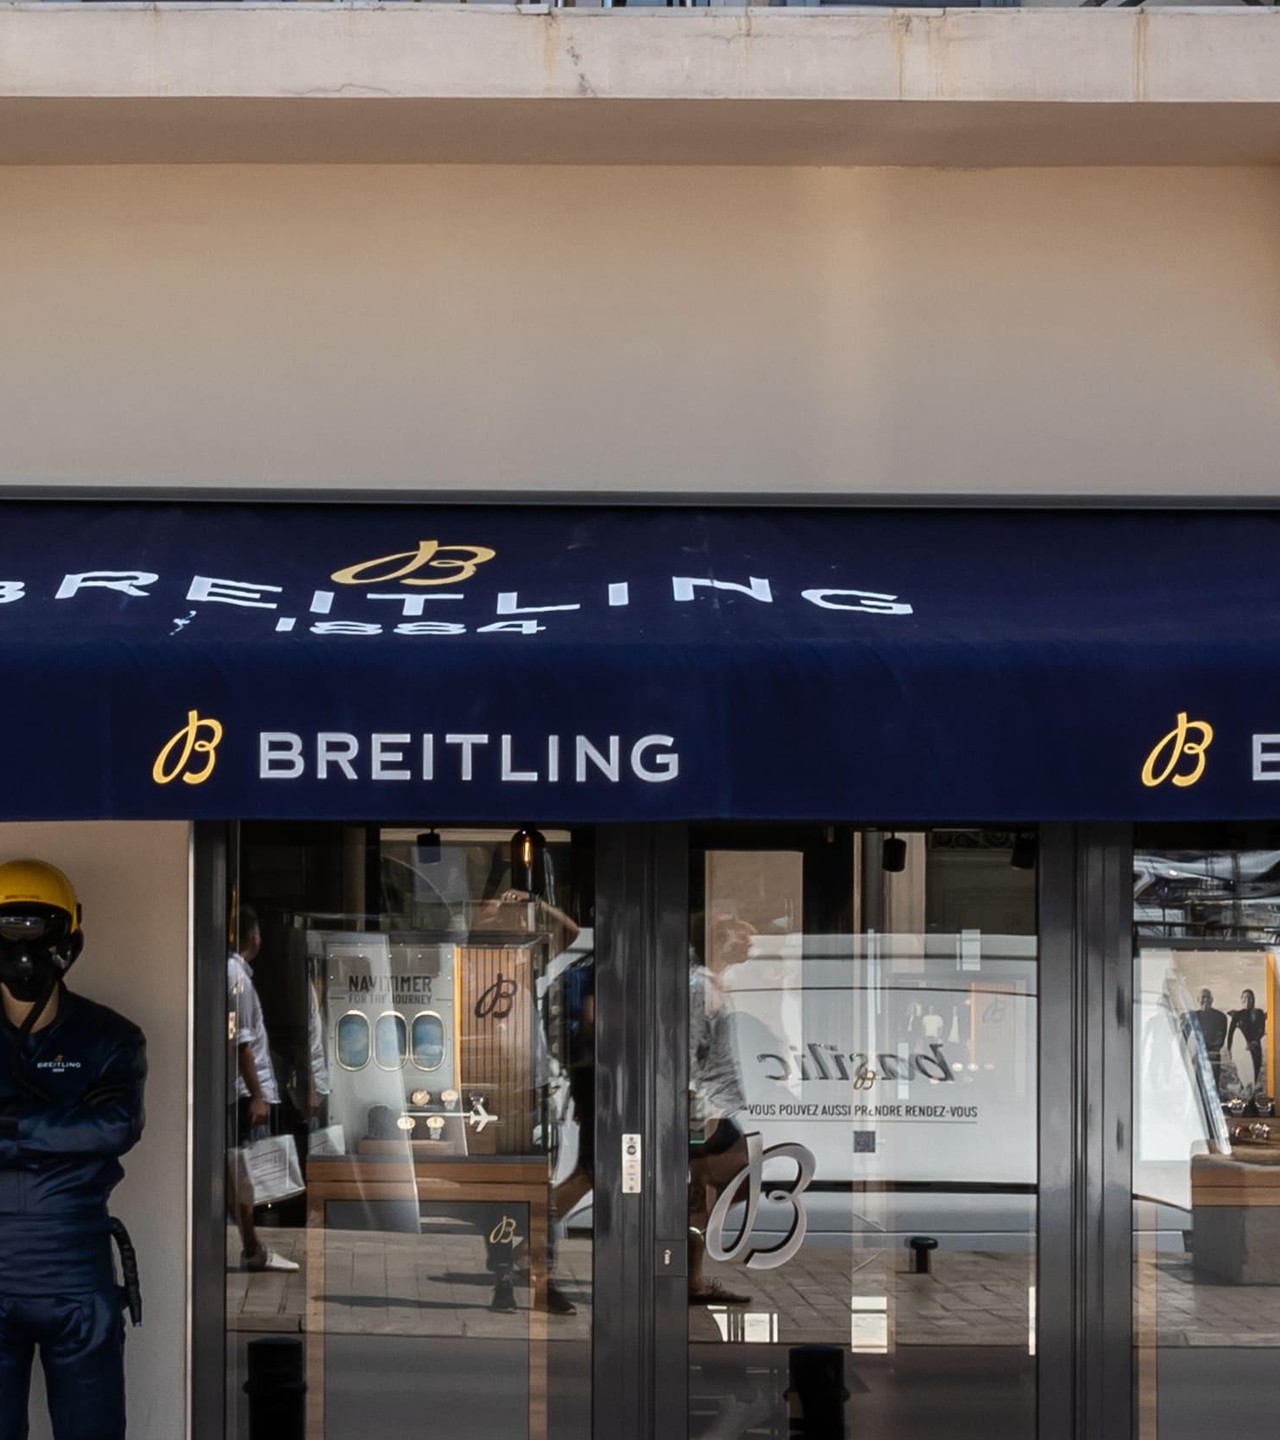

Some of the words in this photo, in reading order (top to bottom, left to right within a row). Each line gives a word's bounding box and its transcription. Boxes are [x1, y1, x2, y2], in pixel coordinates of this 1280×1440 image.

[275, 617, 547, 636] 1884
[259, 731, 679, 783] BREITLING
[348, 975, 432, 993] NAVITIMER
[748, 1103, 776, 1116] VOUS
[779, 1103, 818, 1116] POUVEZ
[821, 1104, 851, 1116] AUSSI
[905, 1105, 978, 1119] RENDEZ-VOUS
